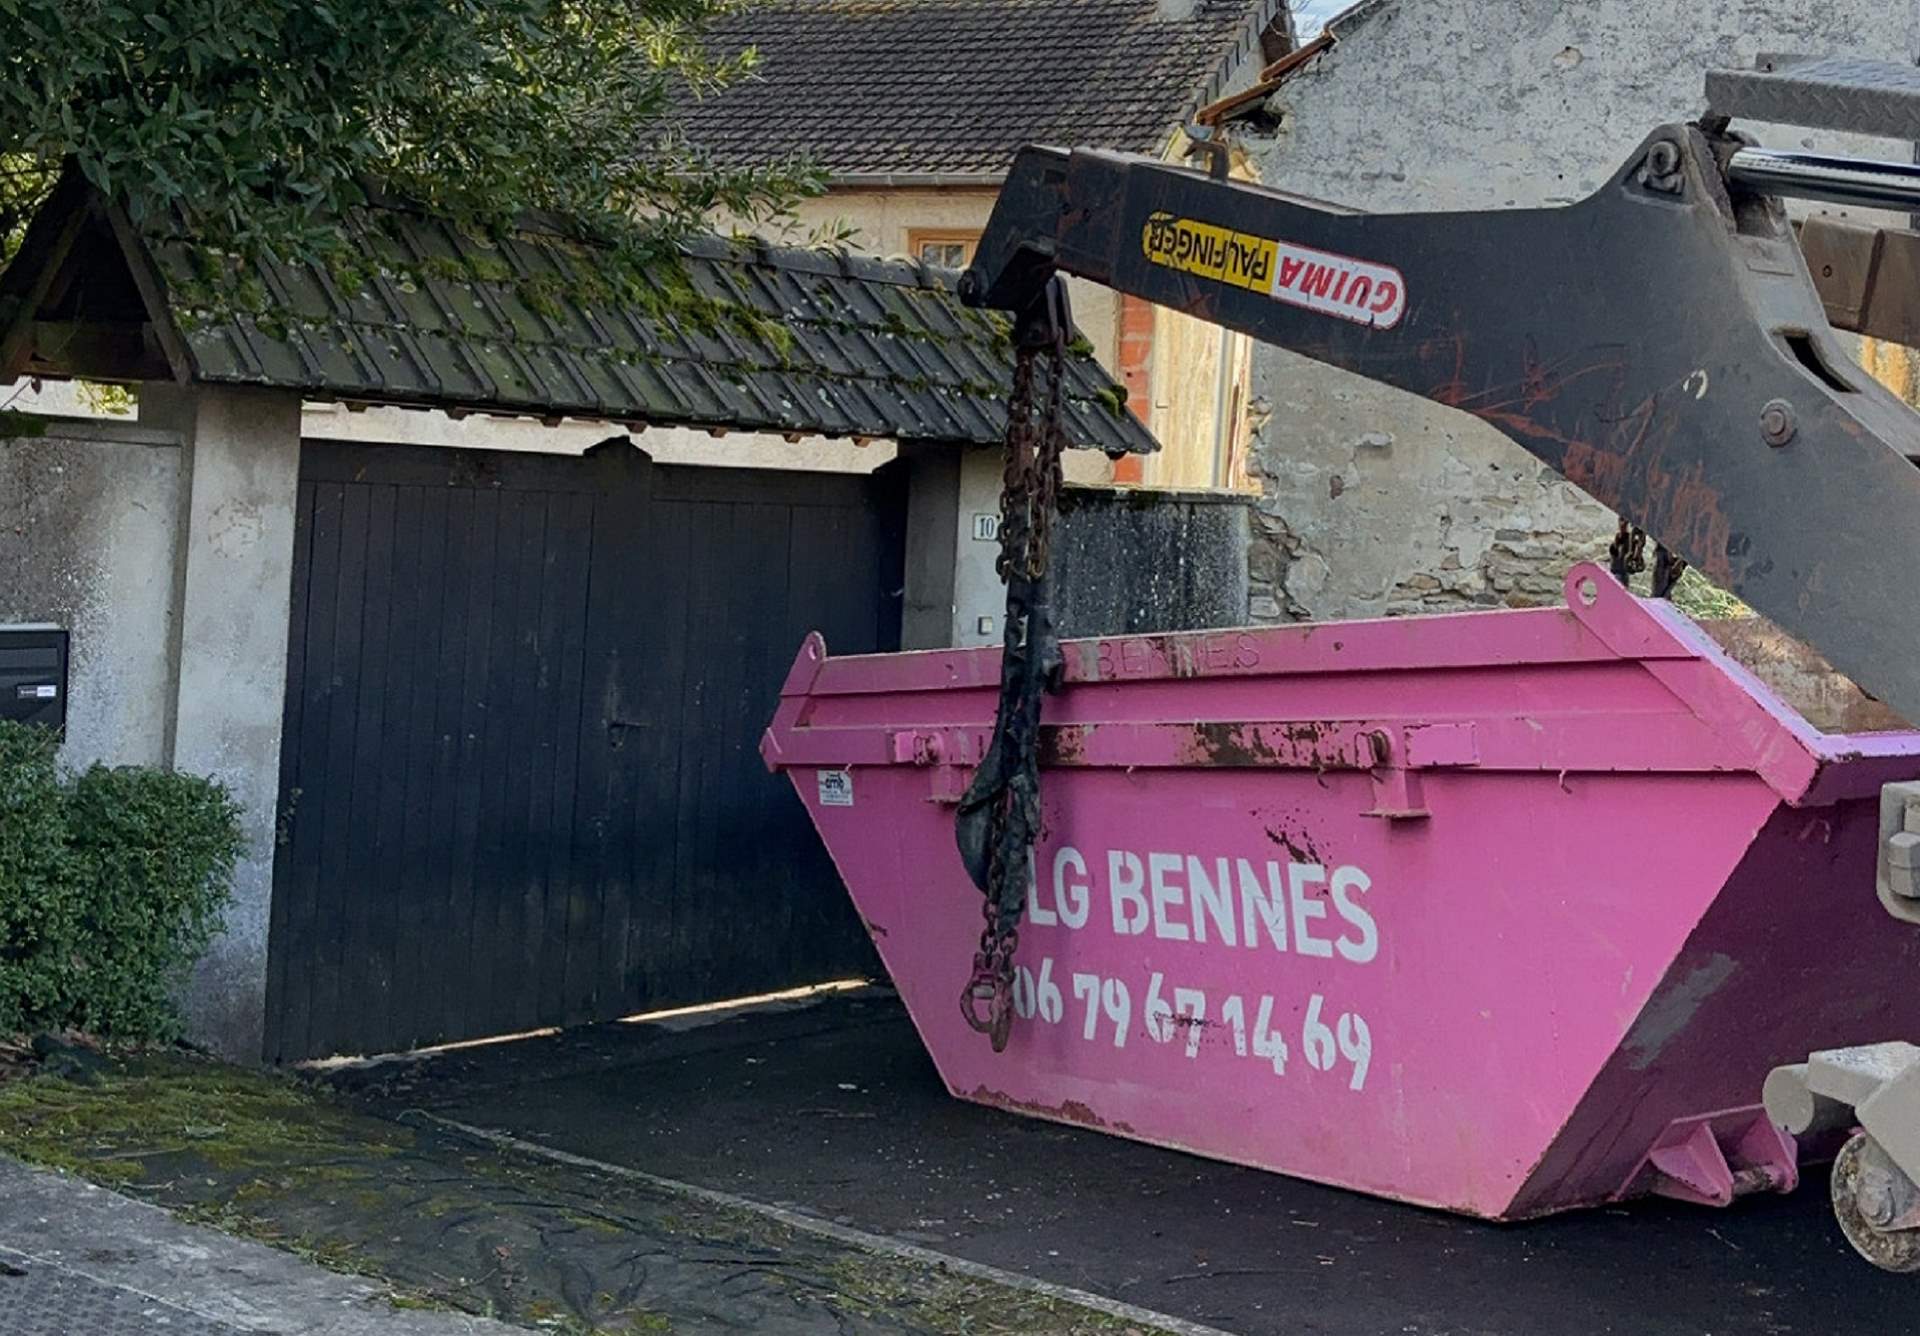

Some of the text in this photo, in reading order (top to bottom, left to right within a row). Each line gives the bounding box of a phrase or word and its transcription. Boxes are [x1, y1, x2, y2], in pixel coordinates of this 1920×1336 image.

[1148, 220, 1397, 314] GUIMA PALFINGER
[980, 517, 995, 538] 10
[1097, 633, 1260, 677] BENNES
[1027, 846, 1378, 963] LG BENNES
[1013, 957, 1372, 1091] 06 79 67 14 69
